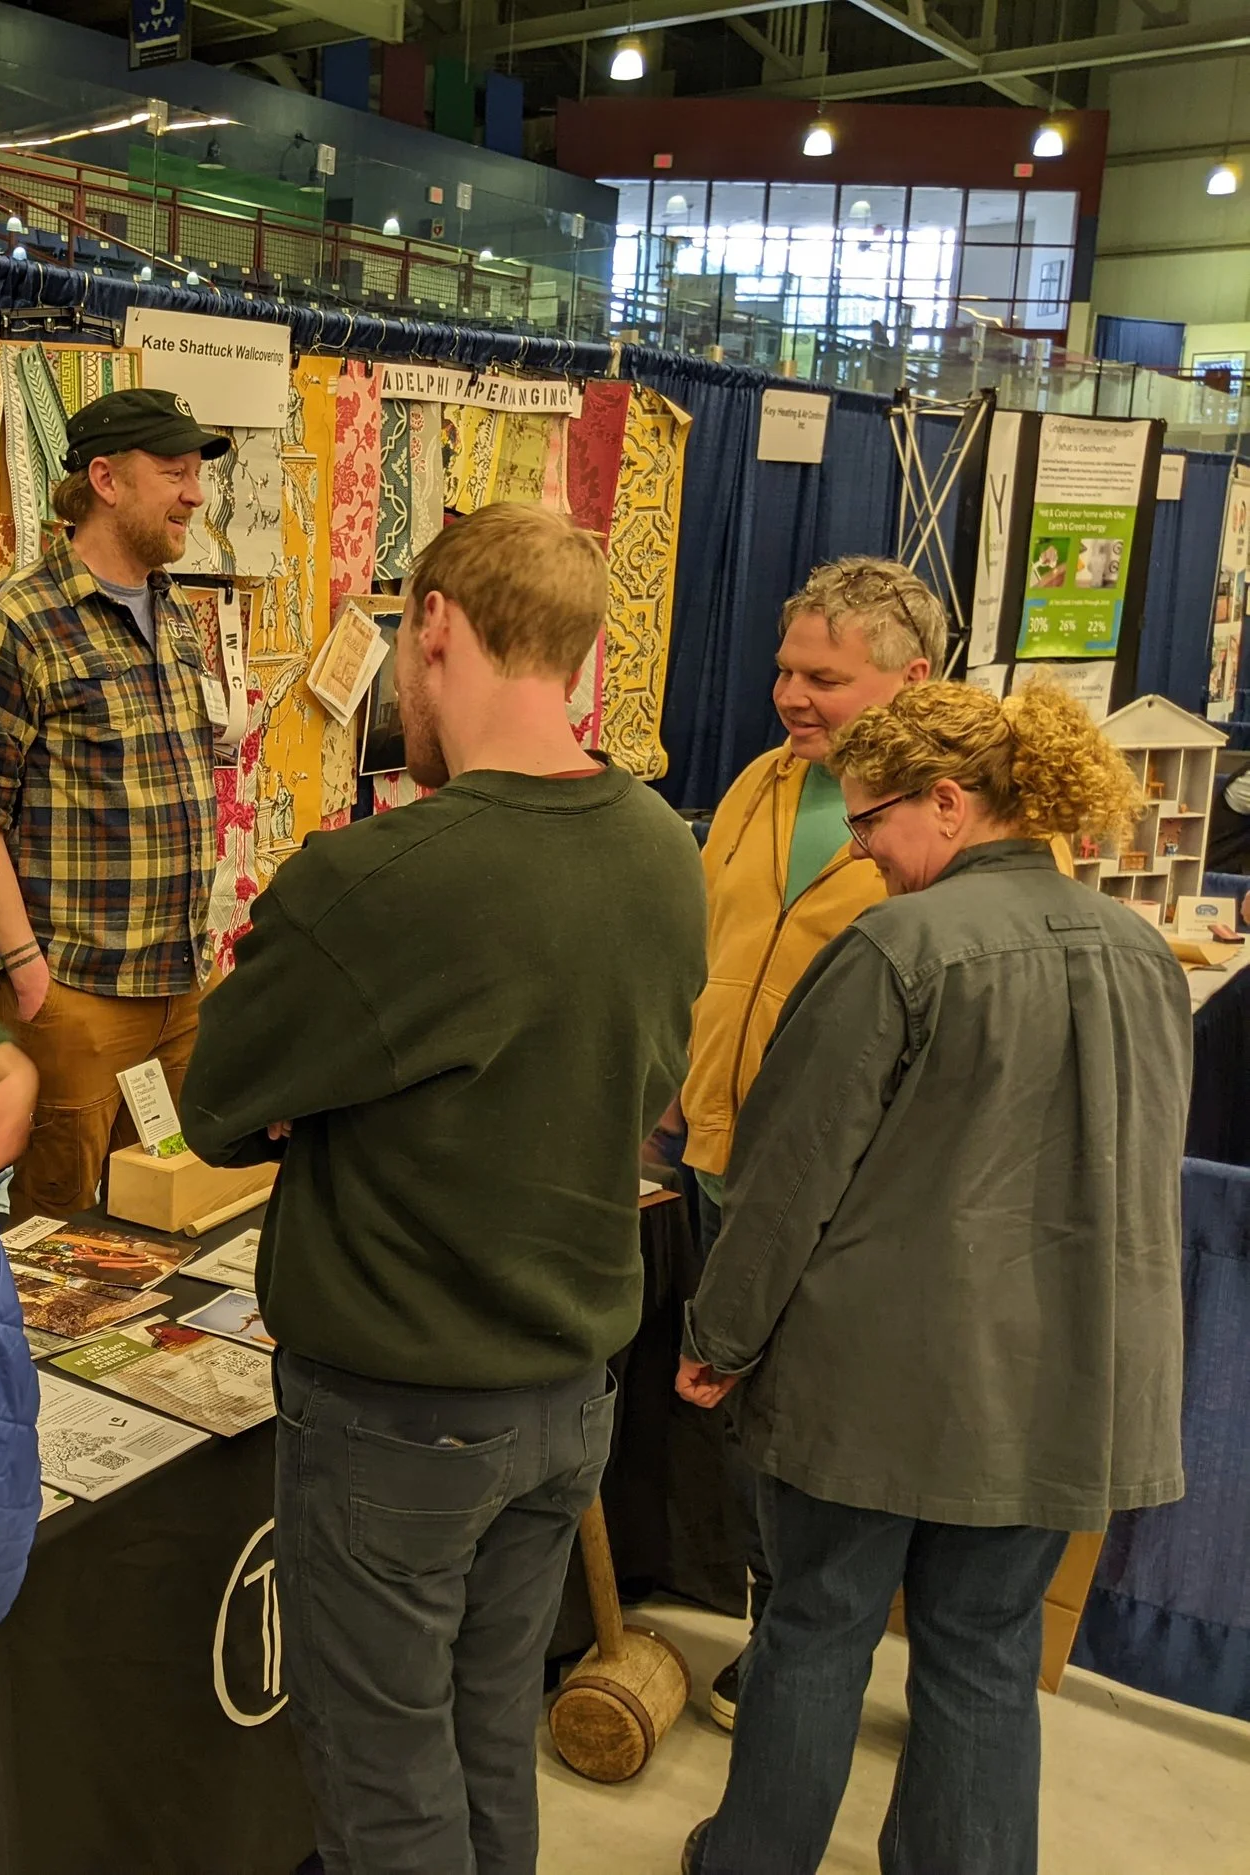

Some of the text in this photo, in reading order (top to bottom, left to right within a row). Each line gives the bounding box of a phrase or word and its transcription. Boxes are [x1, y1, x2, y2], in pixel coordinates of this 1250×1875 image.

[141, 334, 284, 366] Kate Shattuck Wallcoverings
[382, 370, 572, 407] ADELPHI PAPERANGING
[1028, 616, 1049, 633] 30%
[1087, 620, 1107, 633] 22%
[74, 1341, 128, 1367] HEARTWOOD
[83, 1344, 105, 1356] 2024
[91, 1349, 127, 1365] SCHOOL
[93, 1349, 139, 1371] SCHEDULE
